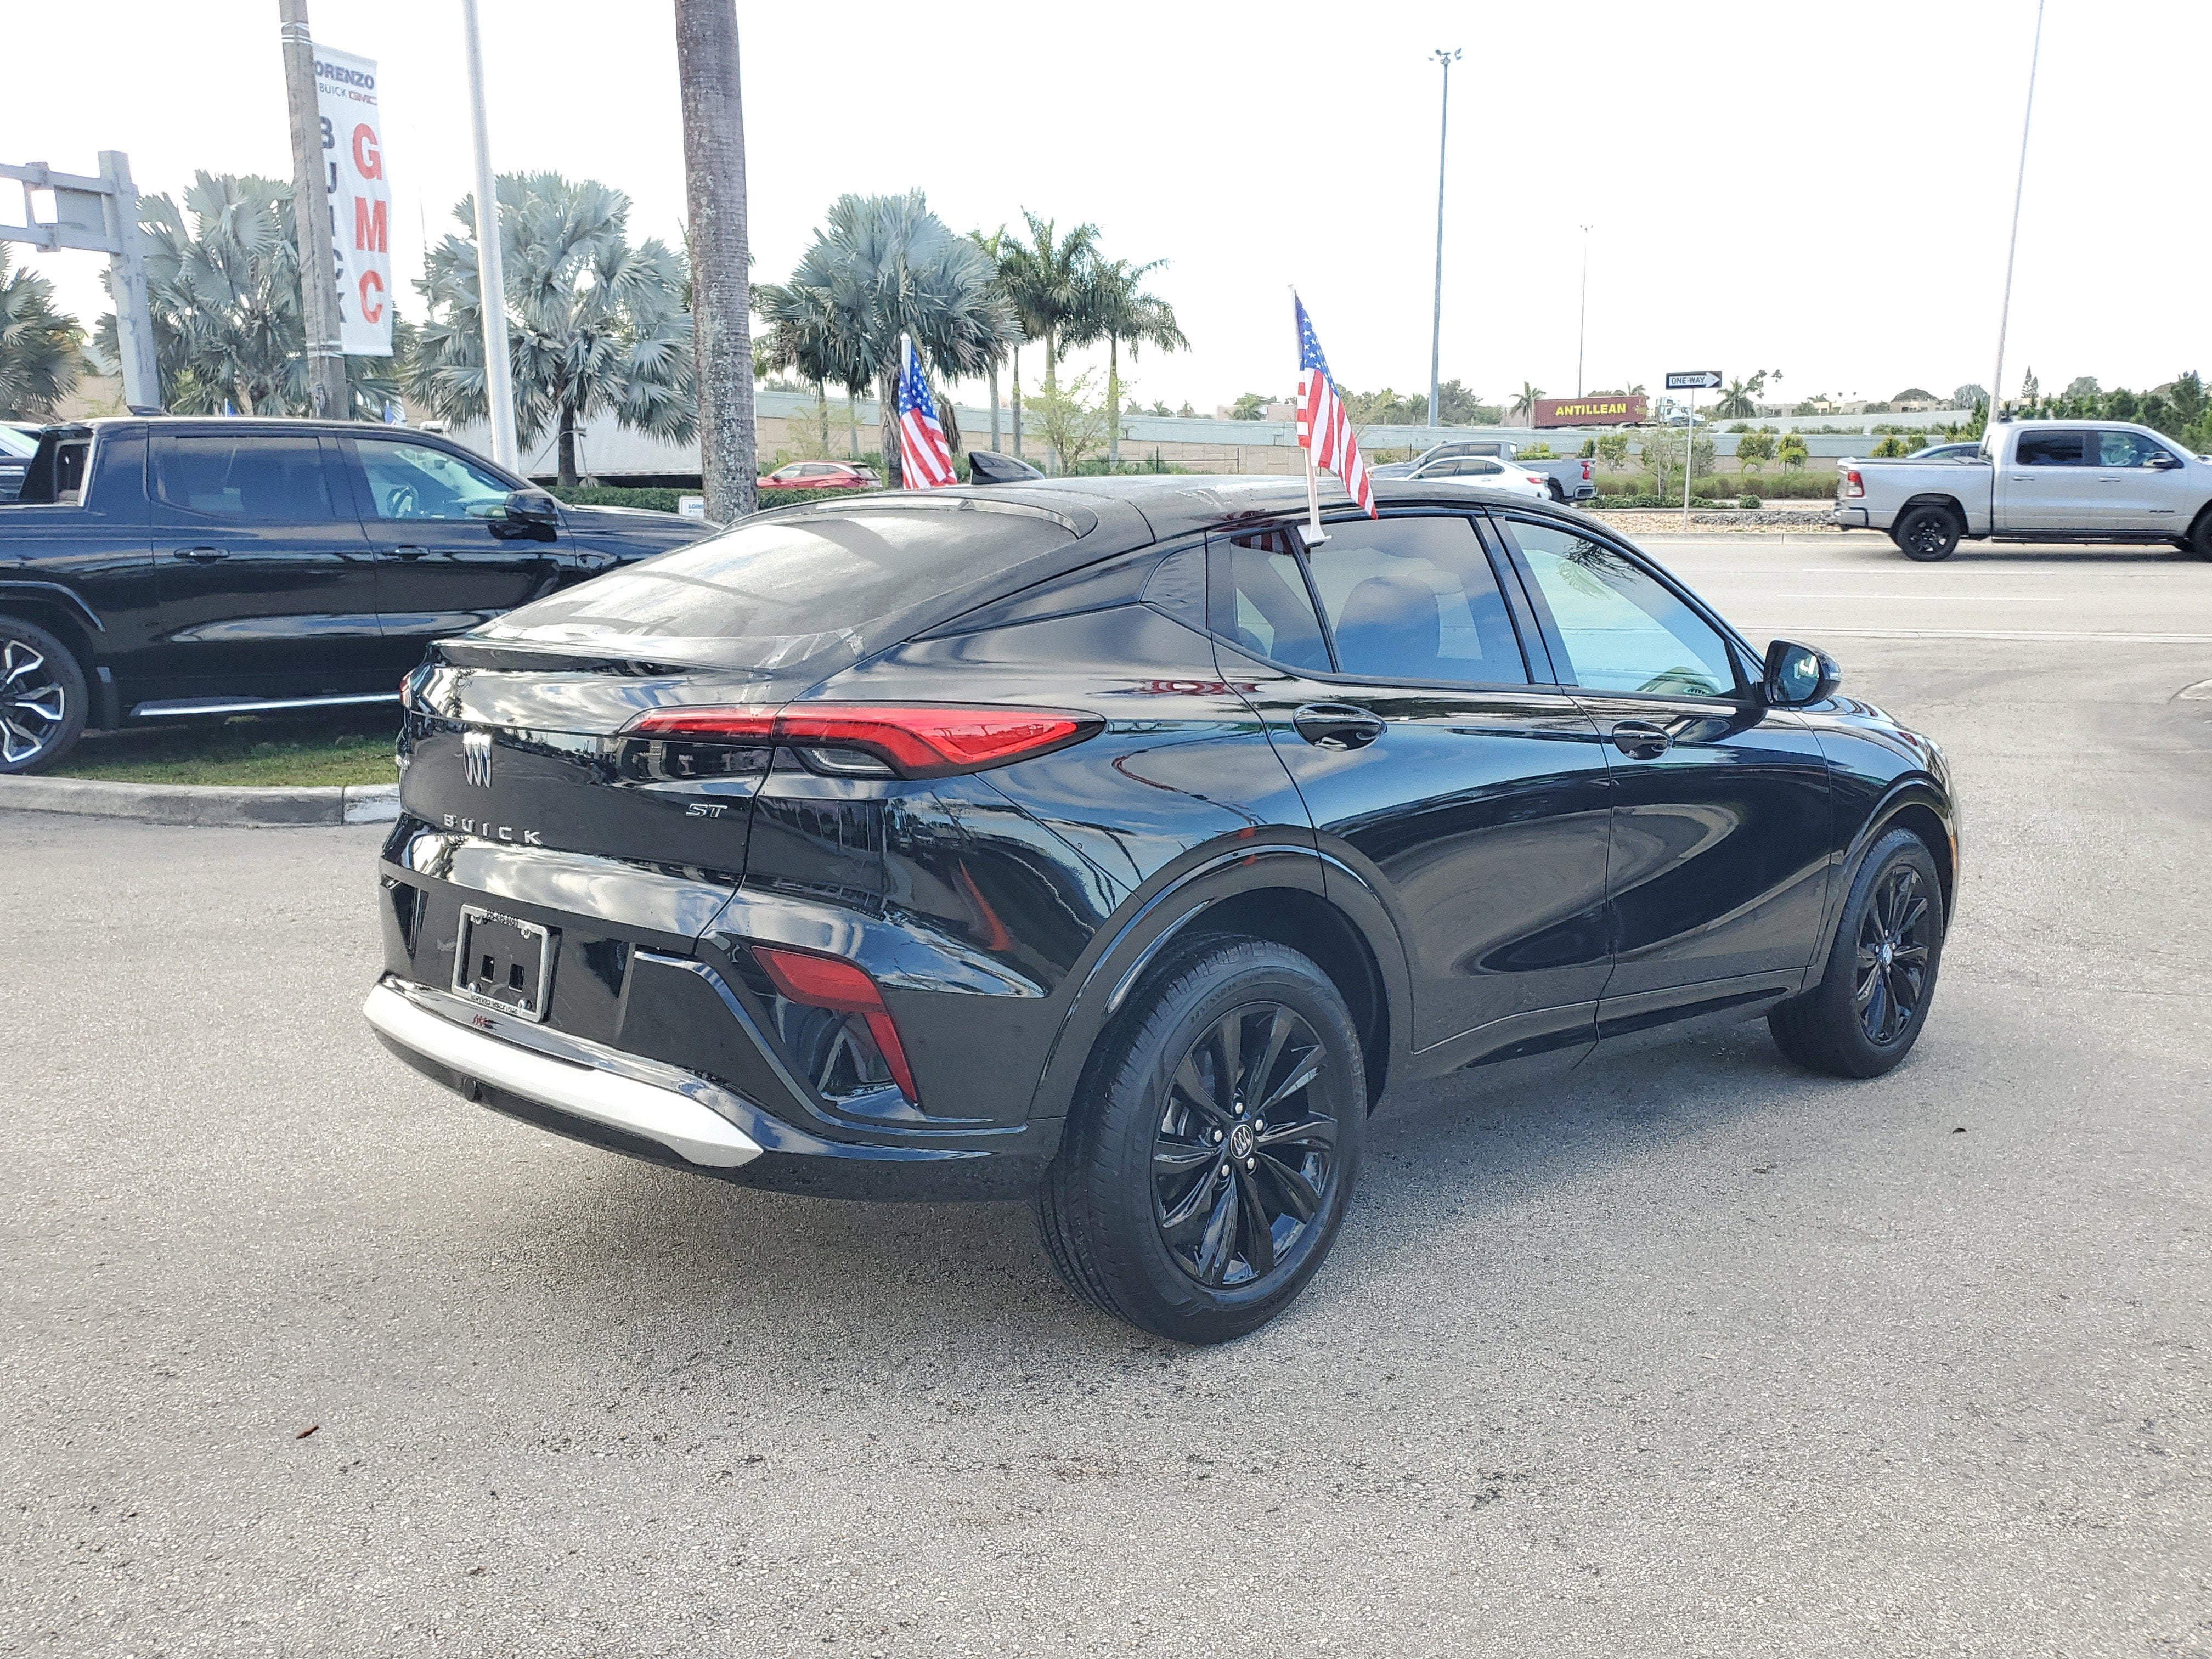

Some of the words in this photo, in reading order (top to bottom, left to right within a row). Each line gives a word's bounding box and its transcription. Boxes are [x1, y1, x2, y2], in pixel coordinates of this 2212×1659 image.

[313, 60, 374, 90] ORENZO
[319, 82, 347, 99] BUICK
[348, 91, 377, 106] GMC
[352, 123, 387, 324] GMC
[1555, 403, 1627, 416] ANTILLEAN
[686, 803, 728, 818] ST
[443, 812, 544, 845] BUICK
